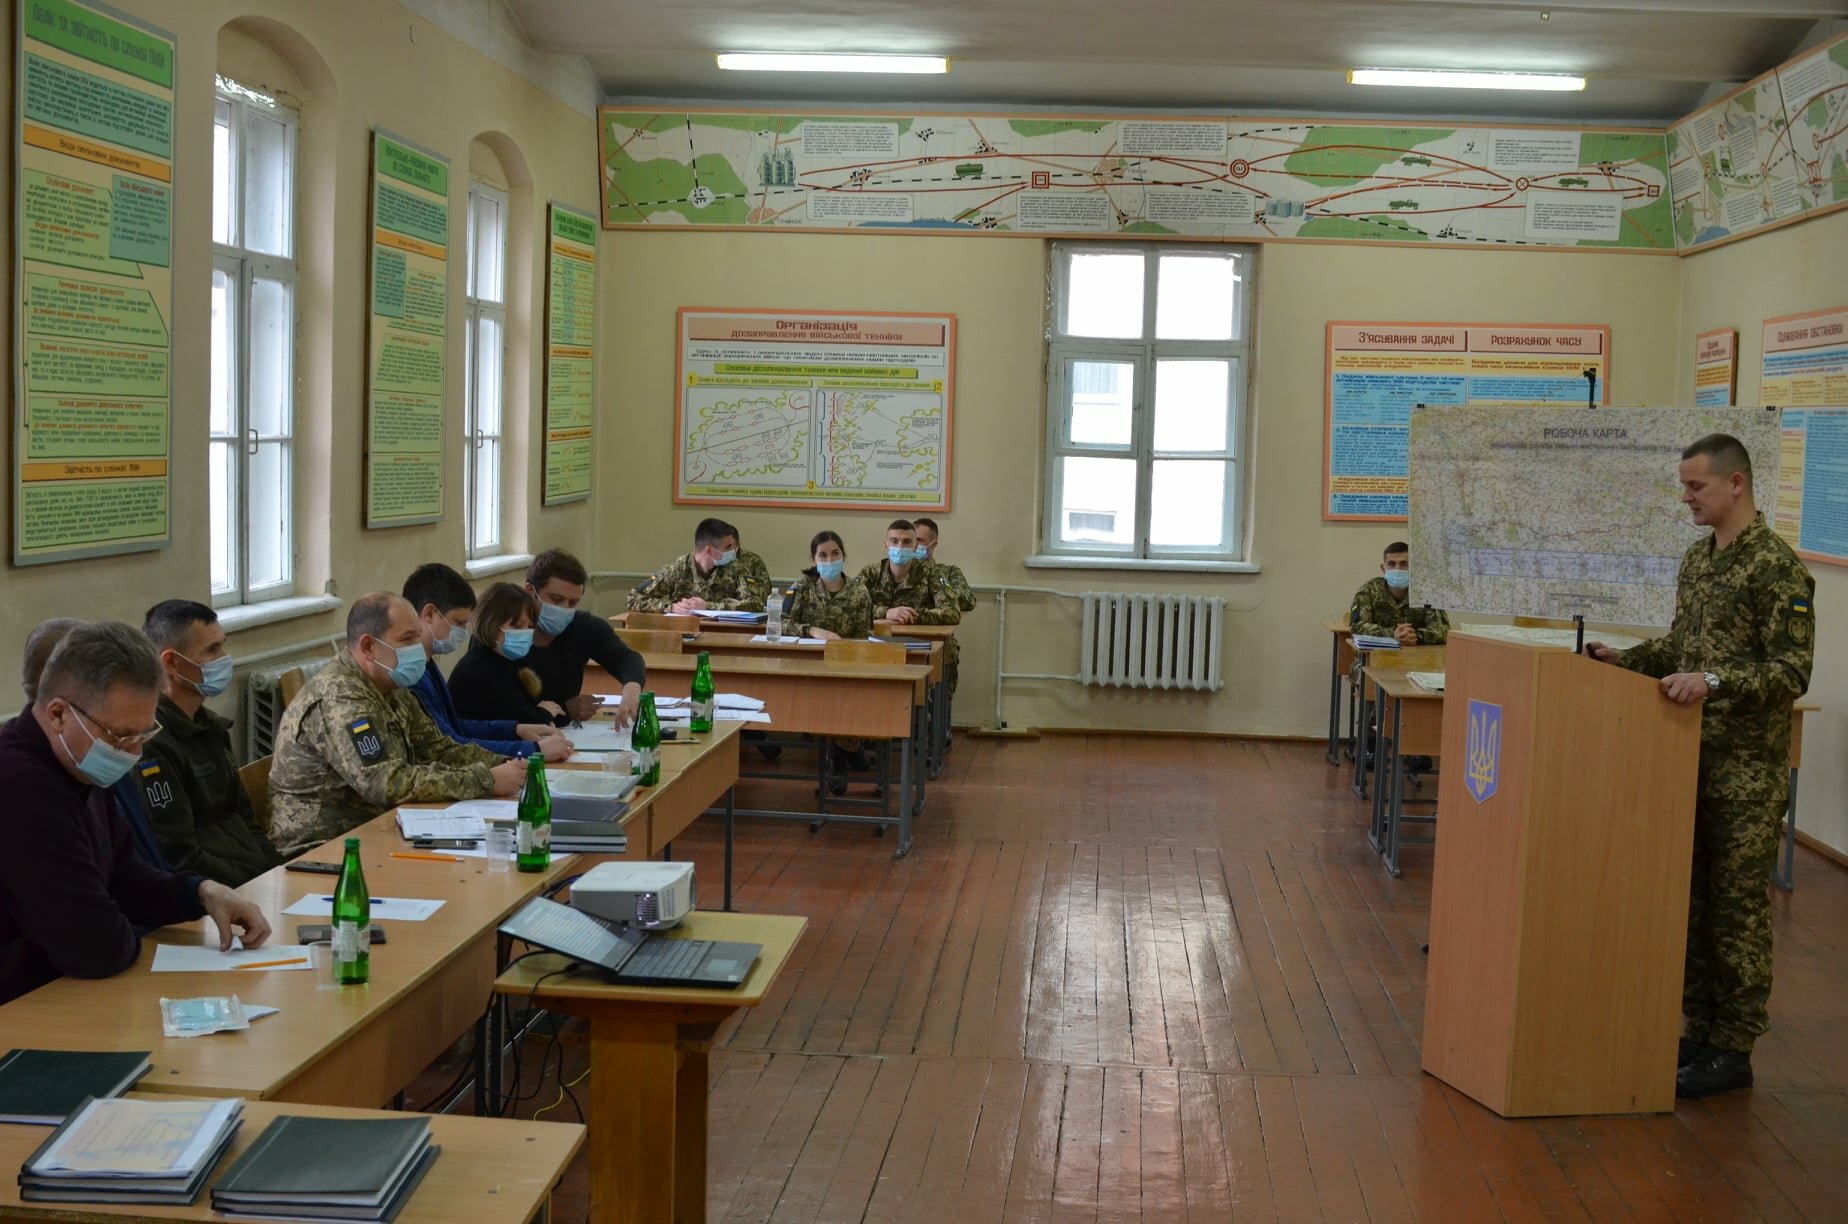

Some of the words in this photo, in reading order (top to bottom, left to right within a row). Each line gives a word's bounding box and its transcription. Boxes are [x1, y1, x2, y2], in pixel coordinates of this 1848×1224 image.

[689, 375, 693, 384] 1
[935, 382, 942, 391] 2
[1543, 428, 1589, 440] РОБОЧА
[1592, 428, 1628, 440] КАРТА
[807, 480, 815, 490] 3
